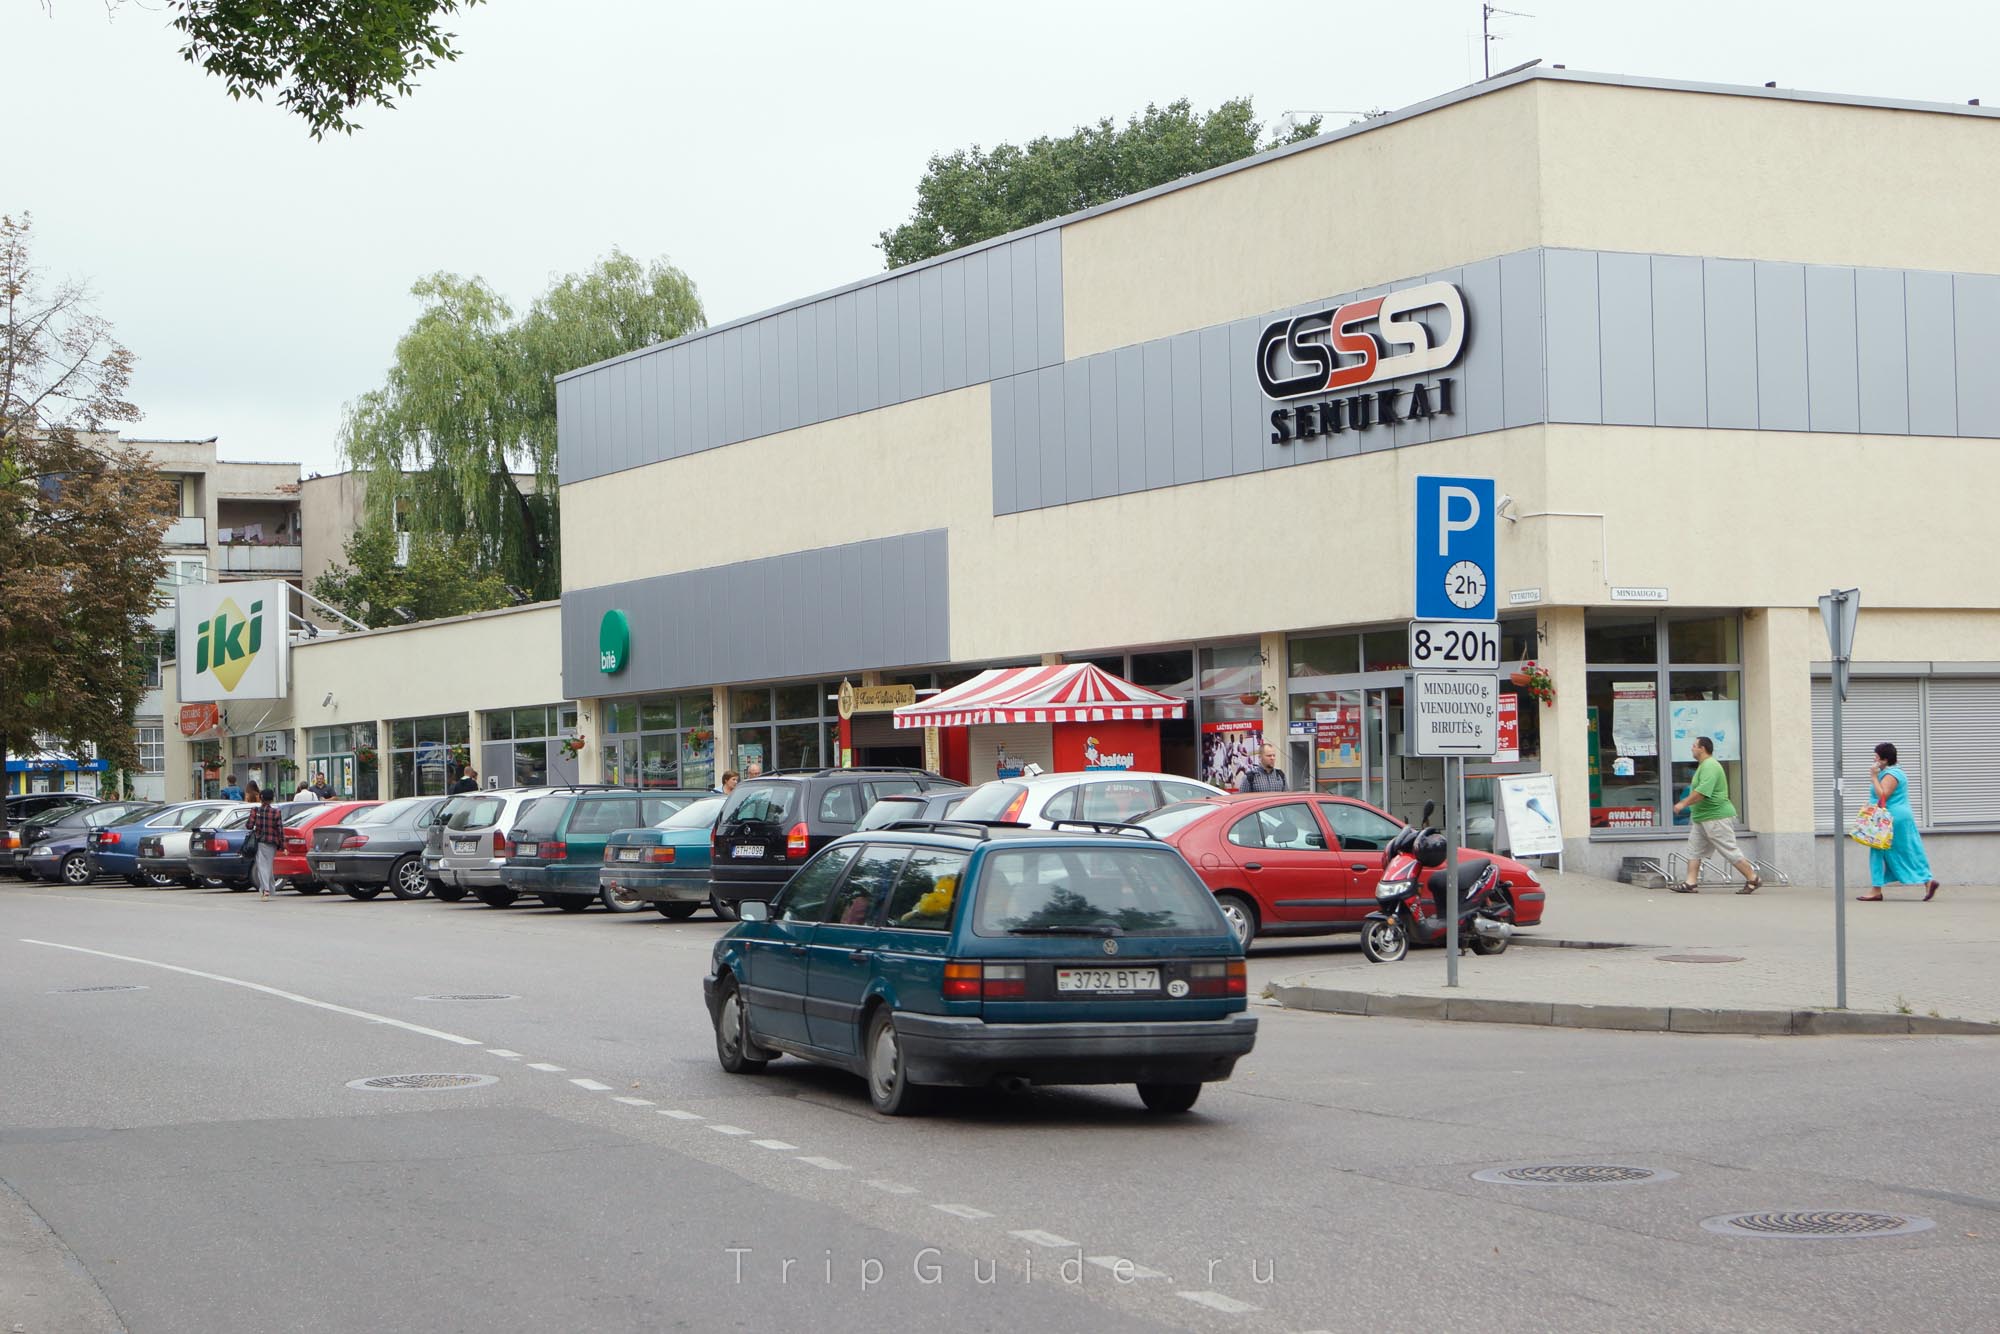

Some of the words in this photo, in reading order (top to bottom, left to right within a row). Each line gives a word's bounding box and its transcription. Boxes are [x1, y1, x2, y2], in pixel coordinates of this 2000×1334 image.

[1270, 377, 1454, 445] SENUKAI
[1439, 485, 1480, 556] P
[1455, 575, 1477, 594] 2h
[196, 599, 263, 674] iki
[1415, 629, 1496, 661] 8-20h
[1424, 682, 1479, 695] MINDAUGO
[1481, 686, 1489, 698] g.
[1420, 702, 1484, 715] VIENUOLYNO
[1486, 706, 1494, 718] g.
[1432, 719, 1473, 734] BIRUTĖS
[1474, 725, 1482, 737] g.
[1608, 808, 1652, 820] AVALYNĖS
[1074, 972, 1112, 989] 3732
[1117, 971, 1156, 988] BT-7
[1171, 983, 1185, 994] BY
